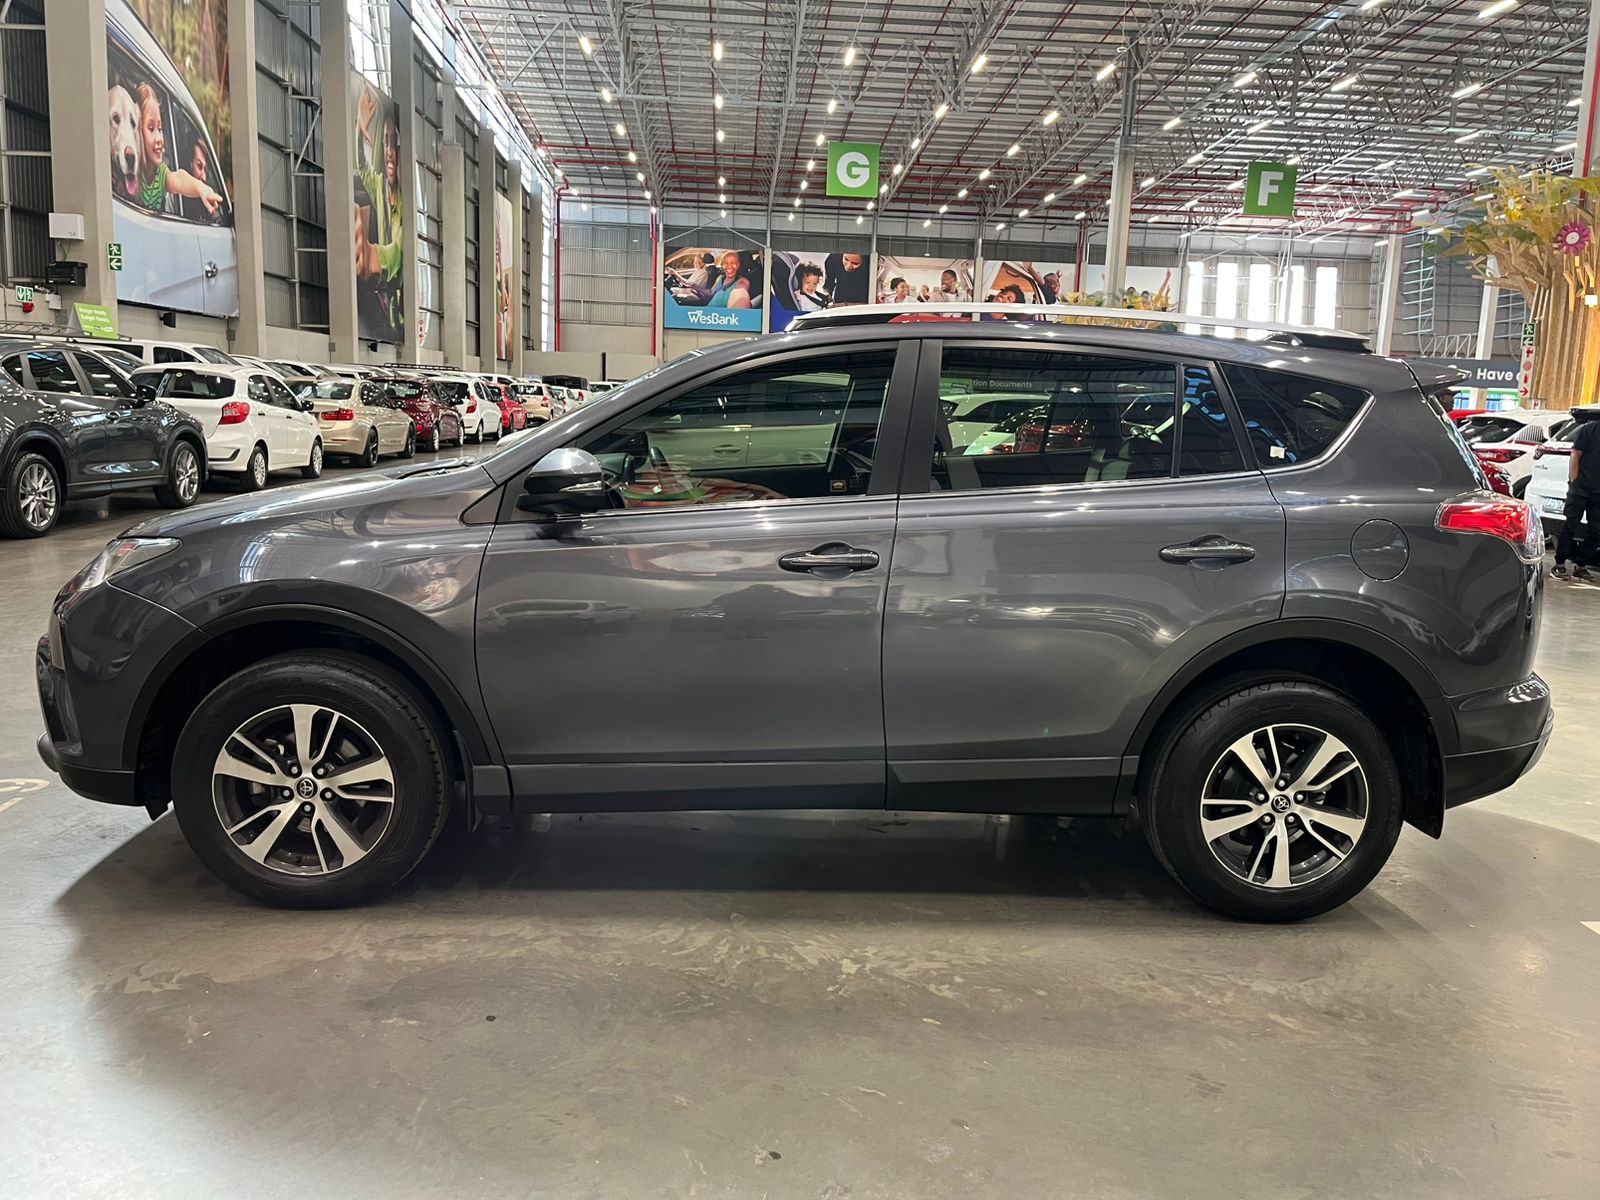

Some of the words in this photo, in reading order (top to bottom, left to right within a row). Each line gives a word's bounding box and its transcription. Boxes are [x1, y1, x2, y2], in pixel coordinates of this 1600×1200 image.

[835, 152, 870, 188] G
[1256, 171, 1284, 207] F
[687, 310, 739, 325] WesBank
[1476, 368, 1514, 381] Have
[989, 380, 1033, 388] Documents
